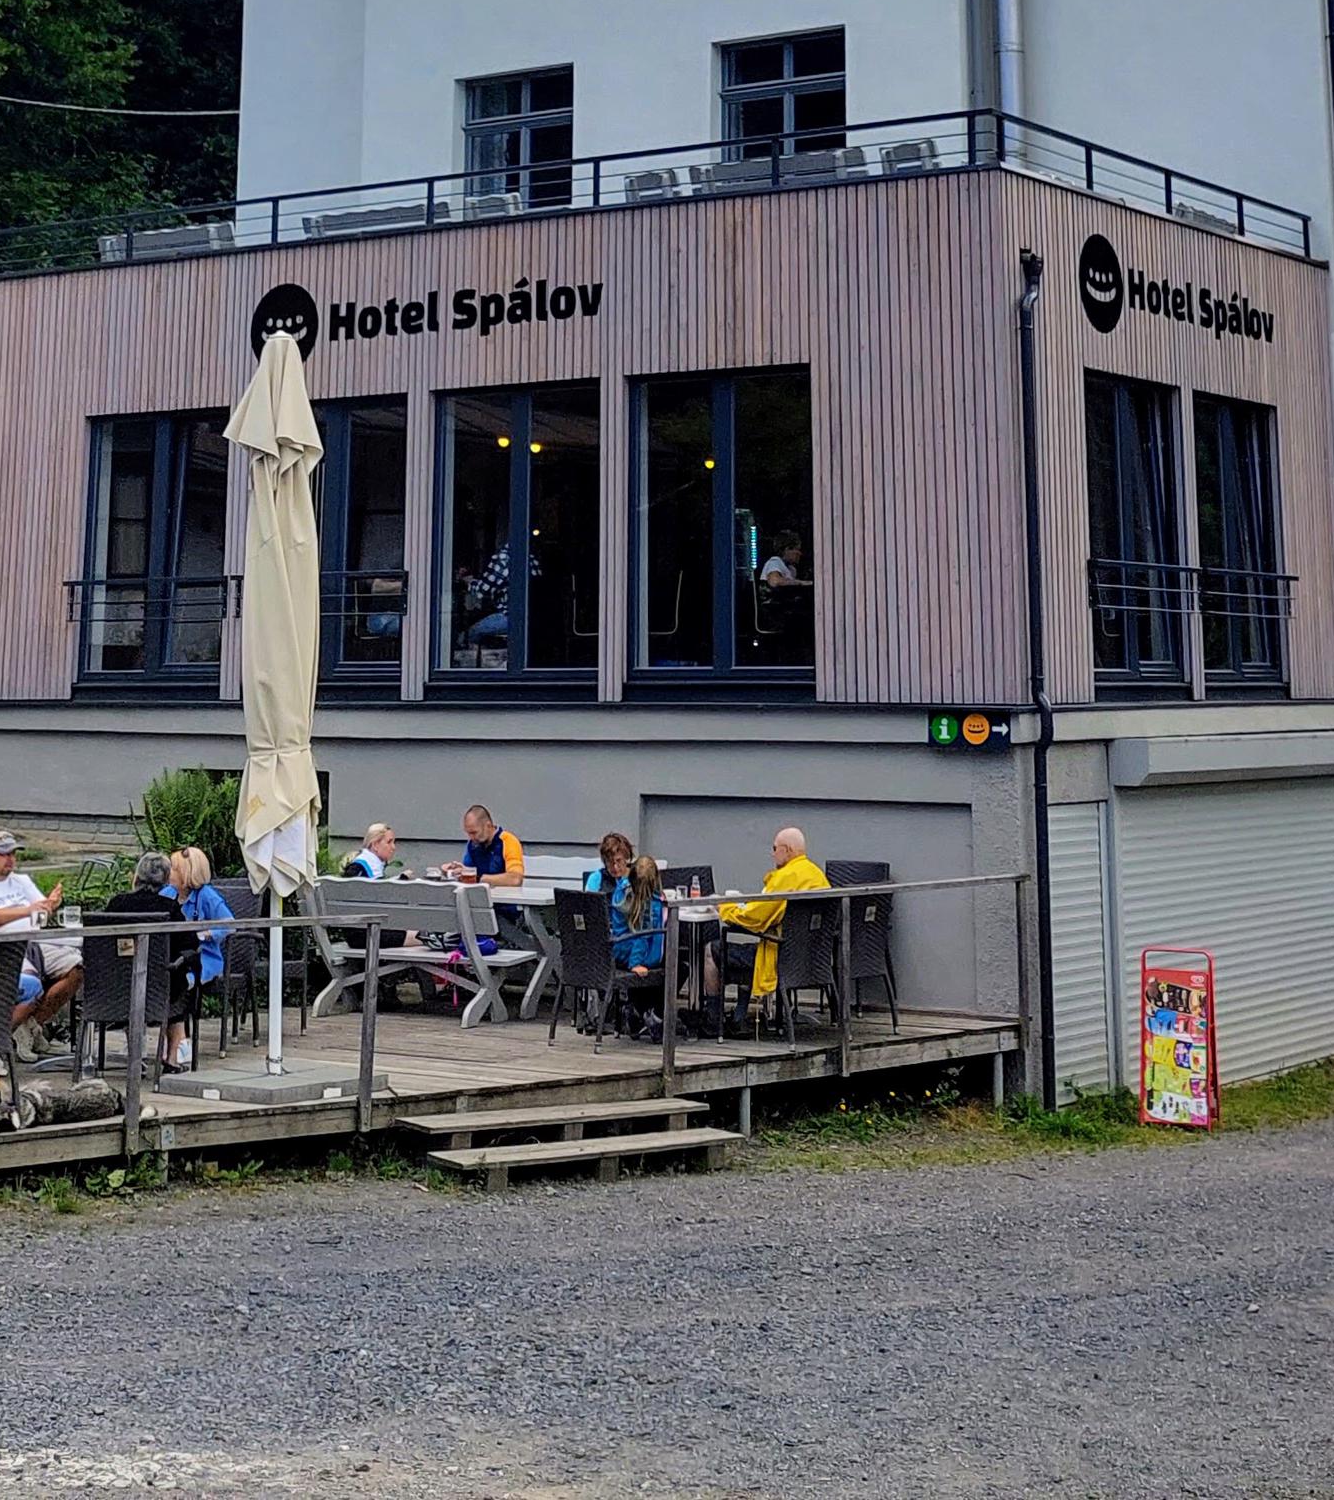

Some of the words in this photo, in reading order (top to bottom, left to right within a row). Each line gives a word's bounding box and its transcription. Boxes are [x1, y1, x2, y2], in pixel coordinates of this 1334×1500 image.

[329, 290, 439, 341] Hotel
[452, 276, 604, 336] Spálov
[1128, 268, 1194, 325] Hotel
[1199, 288, 1274, 343] Spálov
